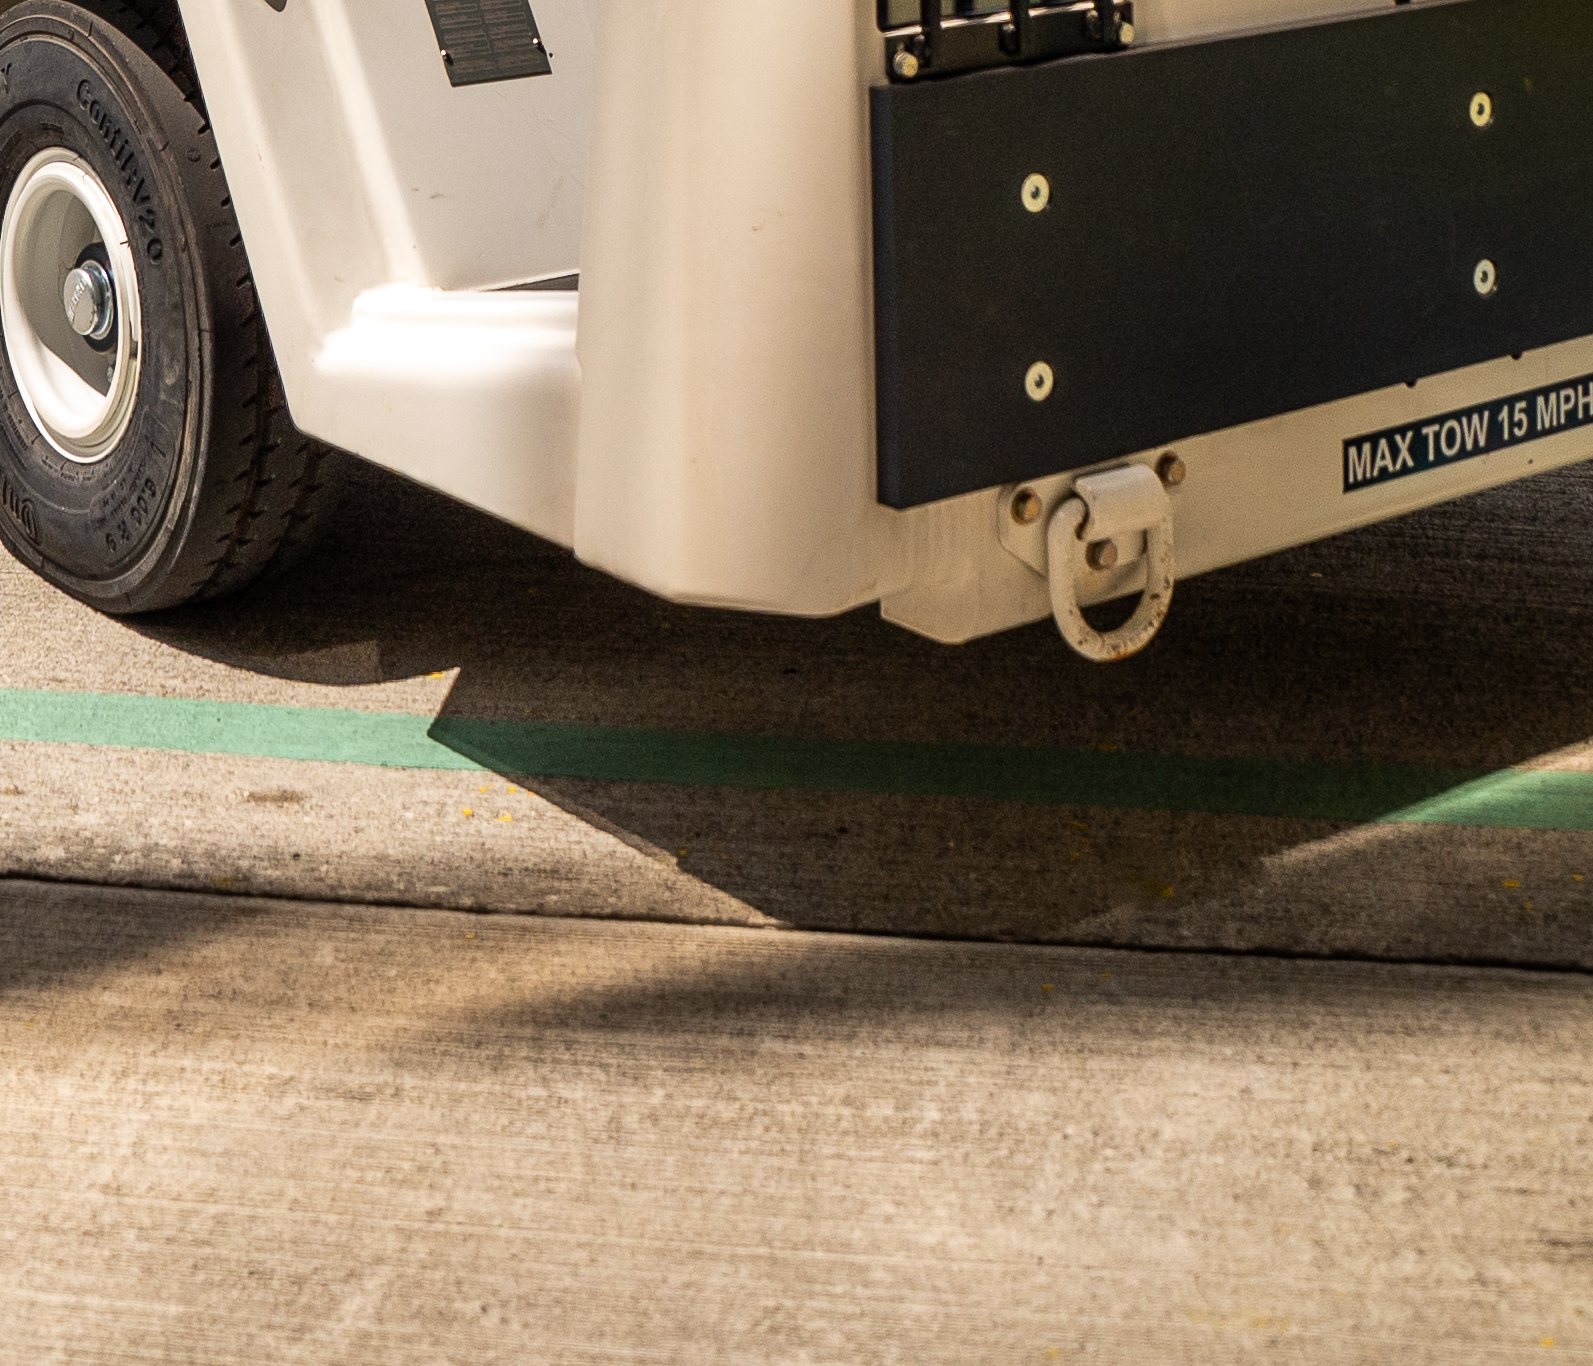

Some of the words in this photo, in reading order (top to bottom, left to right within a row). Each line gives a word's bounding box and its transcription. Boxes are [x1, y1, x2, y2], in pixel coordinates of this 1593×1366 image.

[1347, 430, 1415, 484] MAX
[1421, 410, 1490, 461] TOW
[1498, 400, 1528, 441] 15
